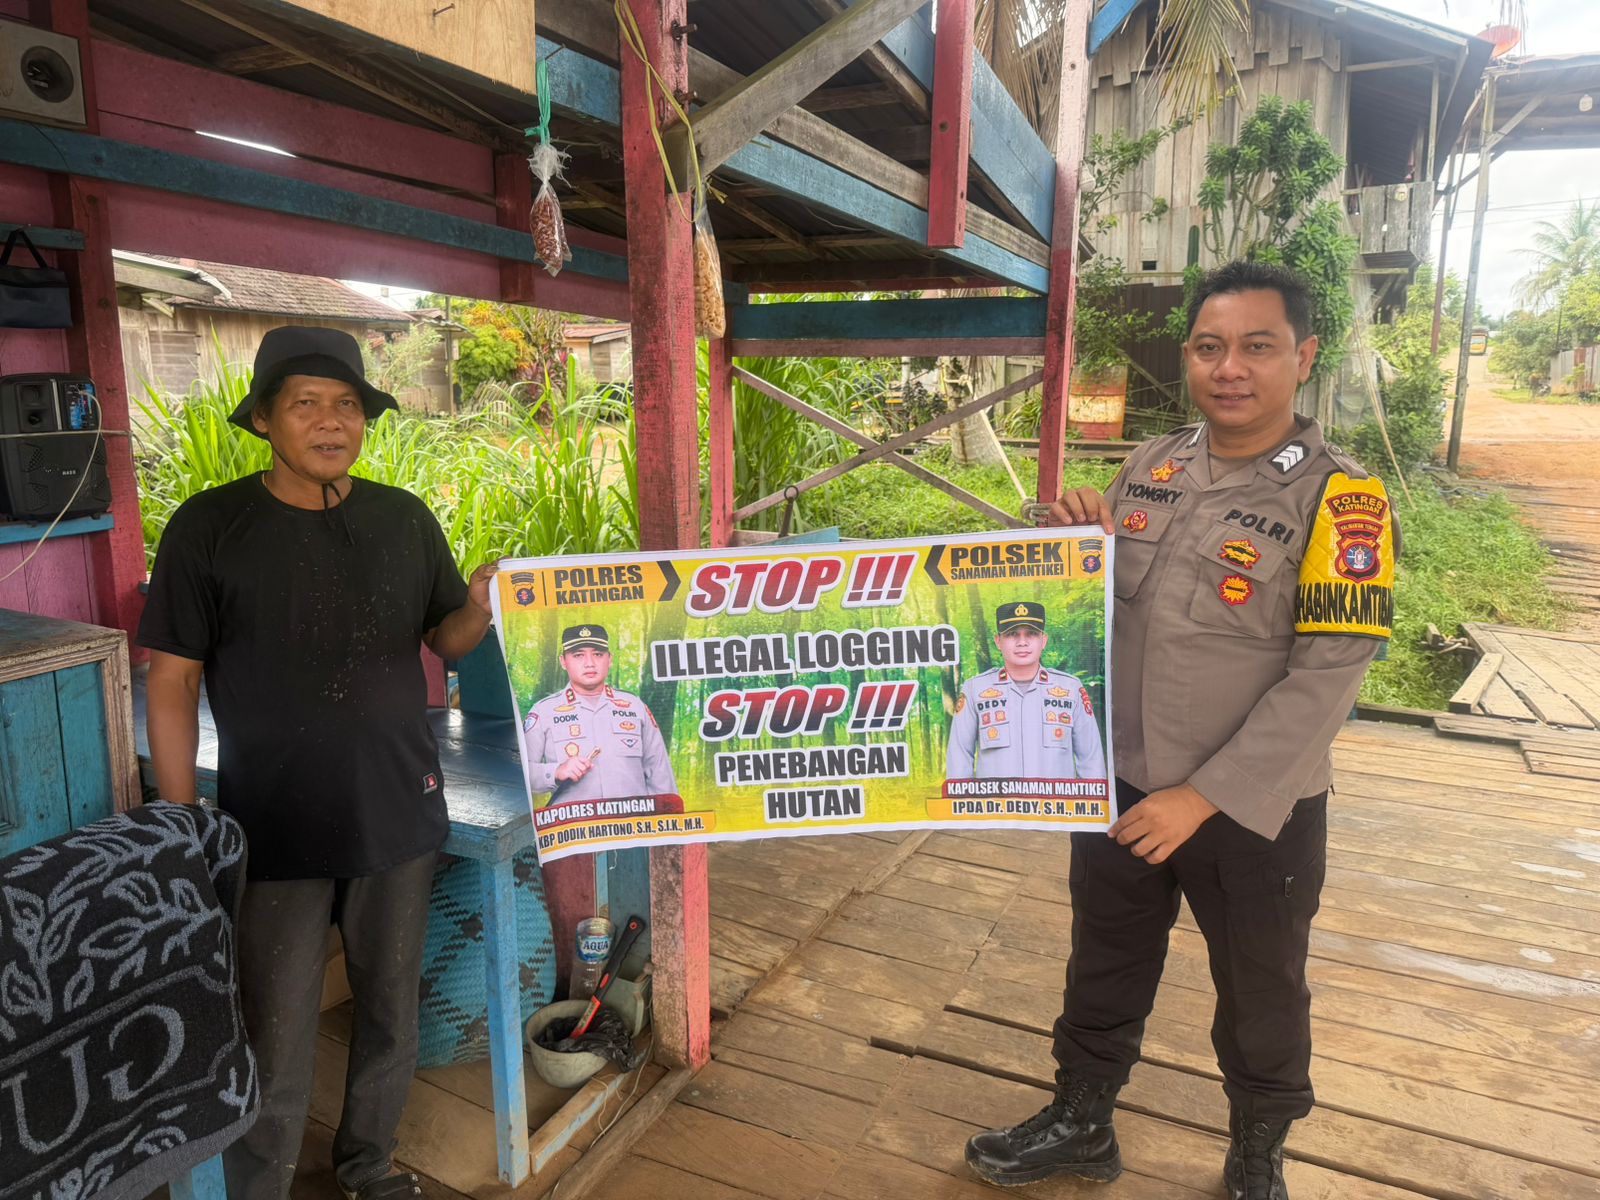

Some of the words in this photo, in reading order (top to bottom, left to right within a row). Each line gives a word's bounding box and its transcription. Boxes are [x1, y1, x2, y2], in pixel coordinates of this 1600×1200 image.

[1125, 482, 1183, 505] YONGKY
[1332, 495, 1383, 509] POLRES
[1223, 508, 1295, 545] POLRI
[950, 541, 1064, 567] POLSEK
[554, 565, 643, 588] POLRES
[951, 565, 1007, 580] SANAMAN
[1009, 562, 1064, 578] MANTIKEI
[690, 559, 841, 612] STOP
[847, 554, 915, 602] !!!
[555, 585, 644, 605] KATINGAN
[655, 637, 790, 678] ILLEGAL
[798, 628, 956, 670] LOGGING
[612, 710, 637, 718] POLRI
[702, 687, 846, 739] STOP
[852, 683, 915, 729] !!!
[977, 699, 1007, 711] DEDY
[1044, 699, 1072, 709] POLRI
[553, 714, 579, 724] DODIK
[718, 746, 905, 783] PENEBANGAN
[947, 782, 999, 794] KAPOLSEK
[1001, 782, 1054, 795] SANAMAN
[1055, 783, 1106, 796] MANTIKEI
[536, 803, 595, 827] KAPOLRES
[596, 799, 655, 815] KATINGAN
[767, 788, 861, 820] HUTAN
[953, 801, 983, 813] IPDA
[986, 802, 1003, 813] Dr.
[1075, 803, 1104, 815] M.H.
[557, 826, 586, 844] DODIK
[684, 817, 704, 830] M.H.
[583, 940, 609, 953] AQUA
